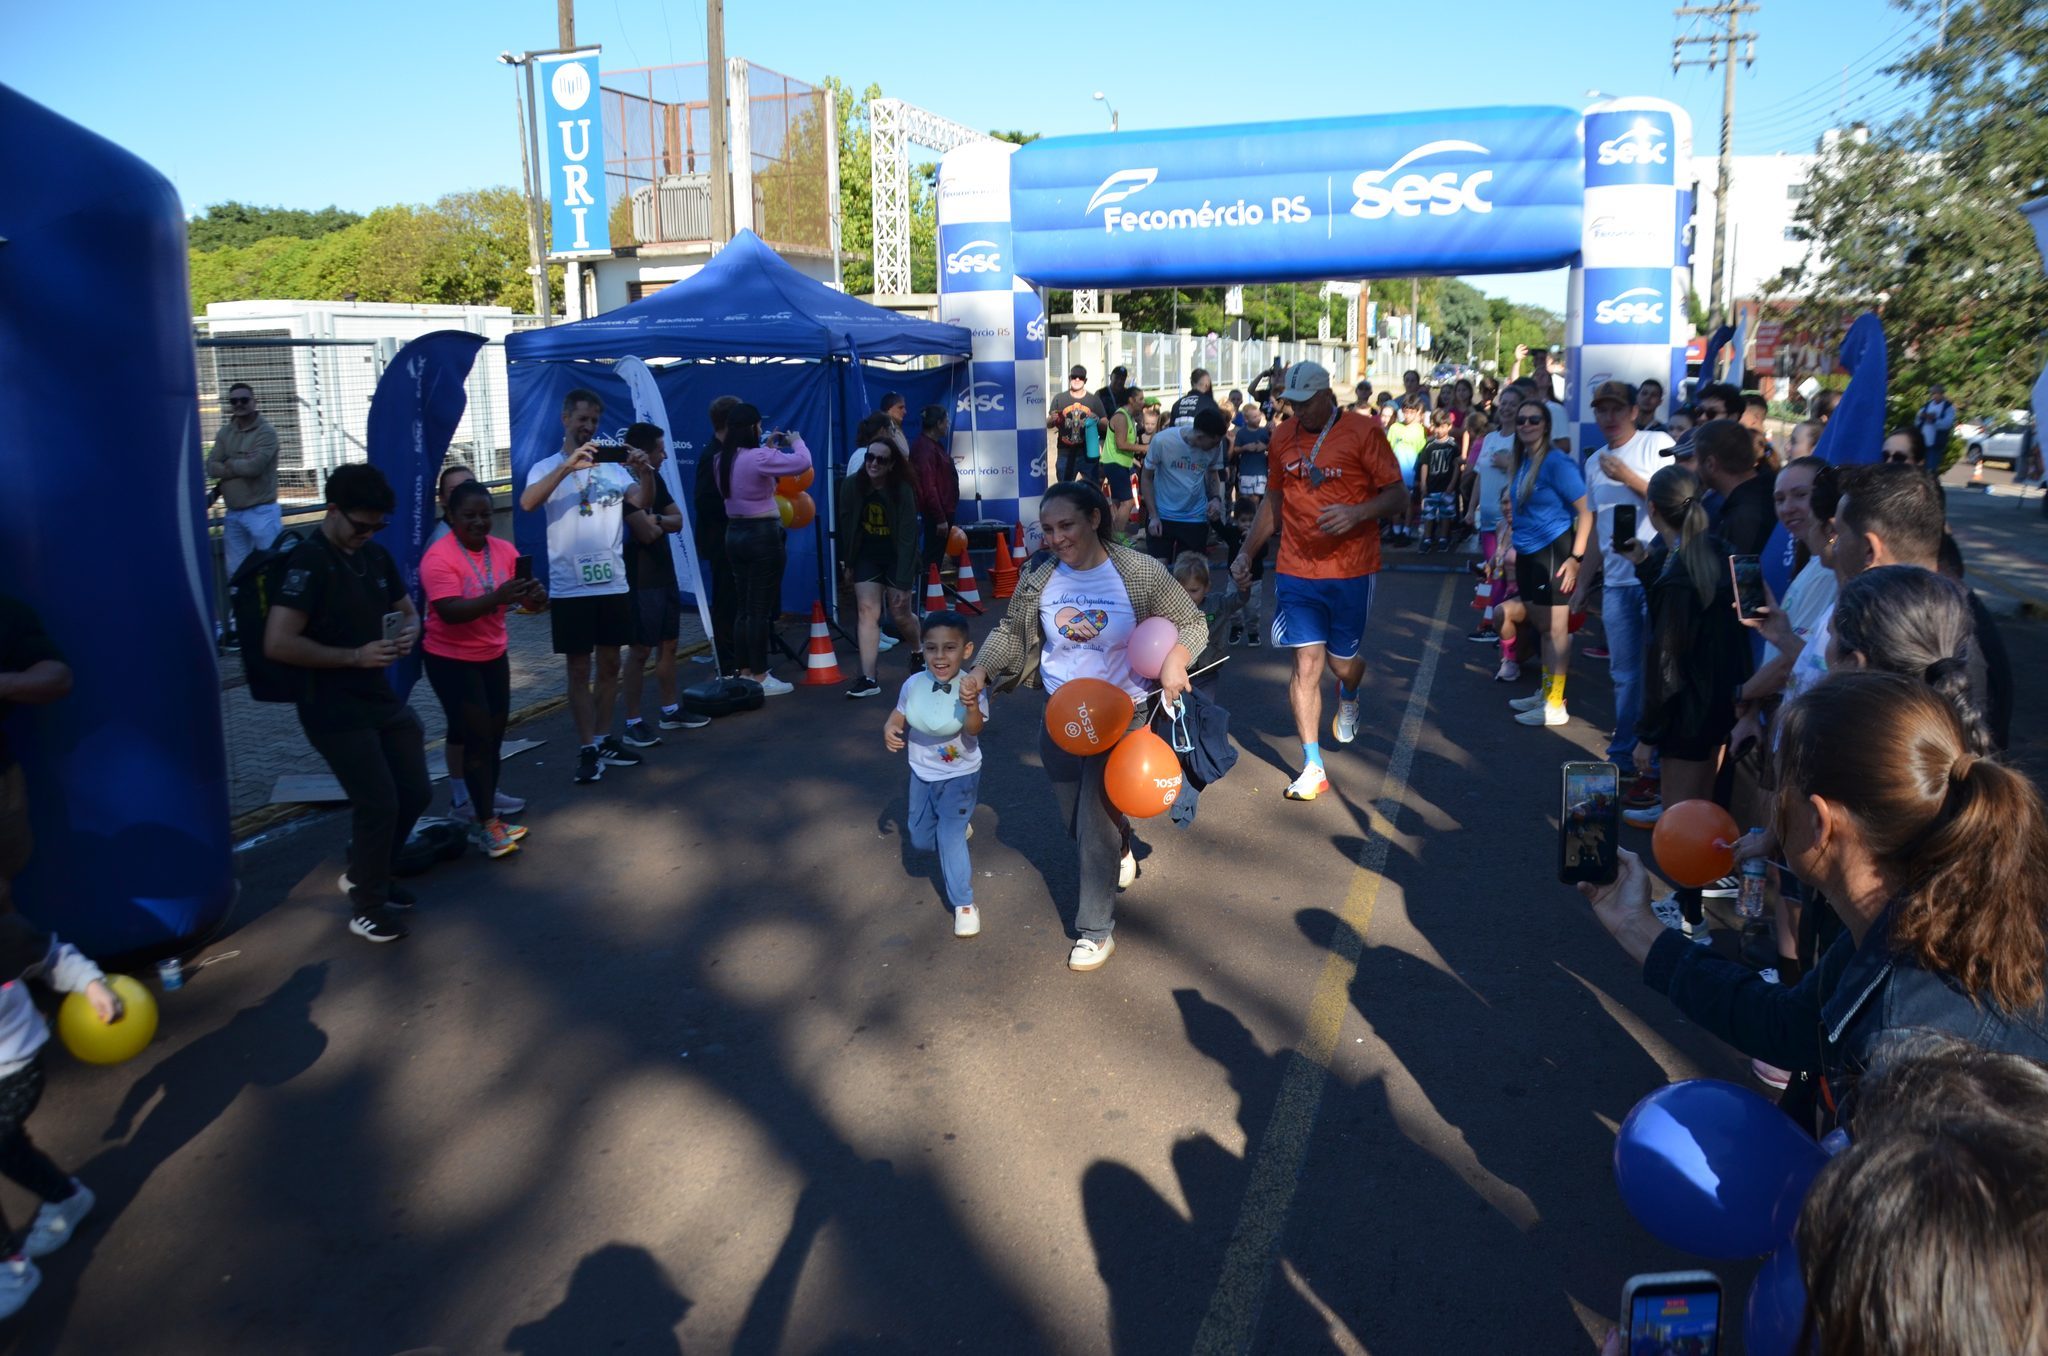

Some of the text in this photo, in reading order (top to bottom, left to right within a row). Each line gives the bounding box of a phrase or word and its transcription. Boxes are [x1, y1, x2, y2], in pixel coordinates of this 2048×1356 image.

[558, 118, 594, 249] URI
[1104, 195, 1311, 233] Fecomércio RS
[582, 562, 612, 582] 566
[1077, 702, 1100, 745] CRESOL
